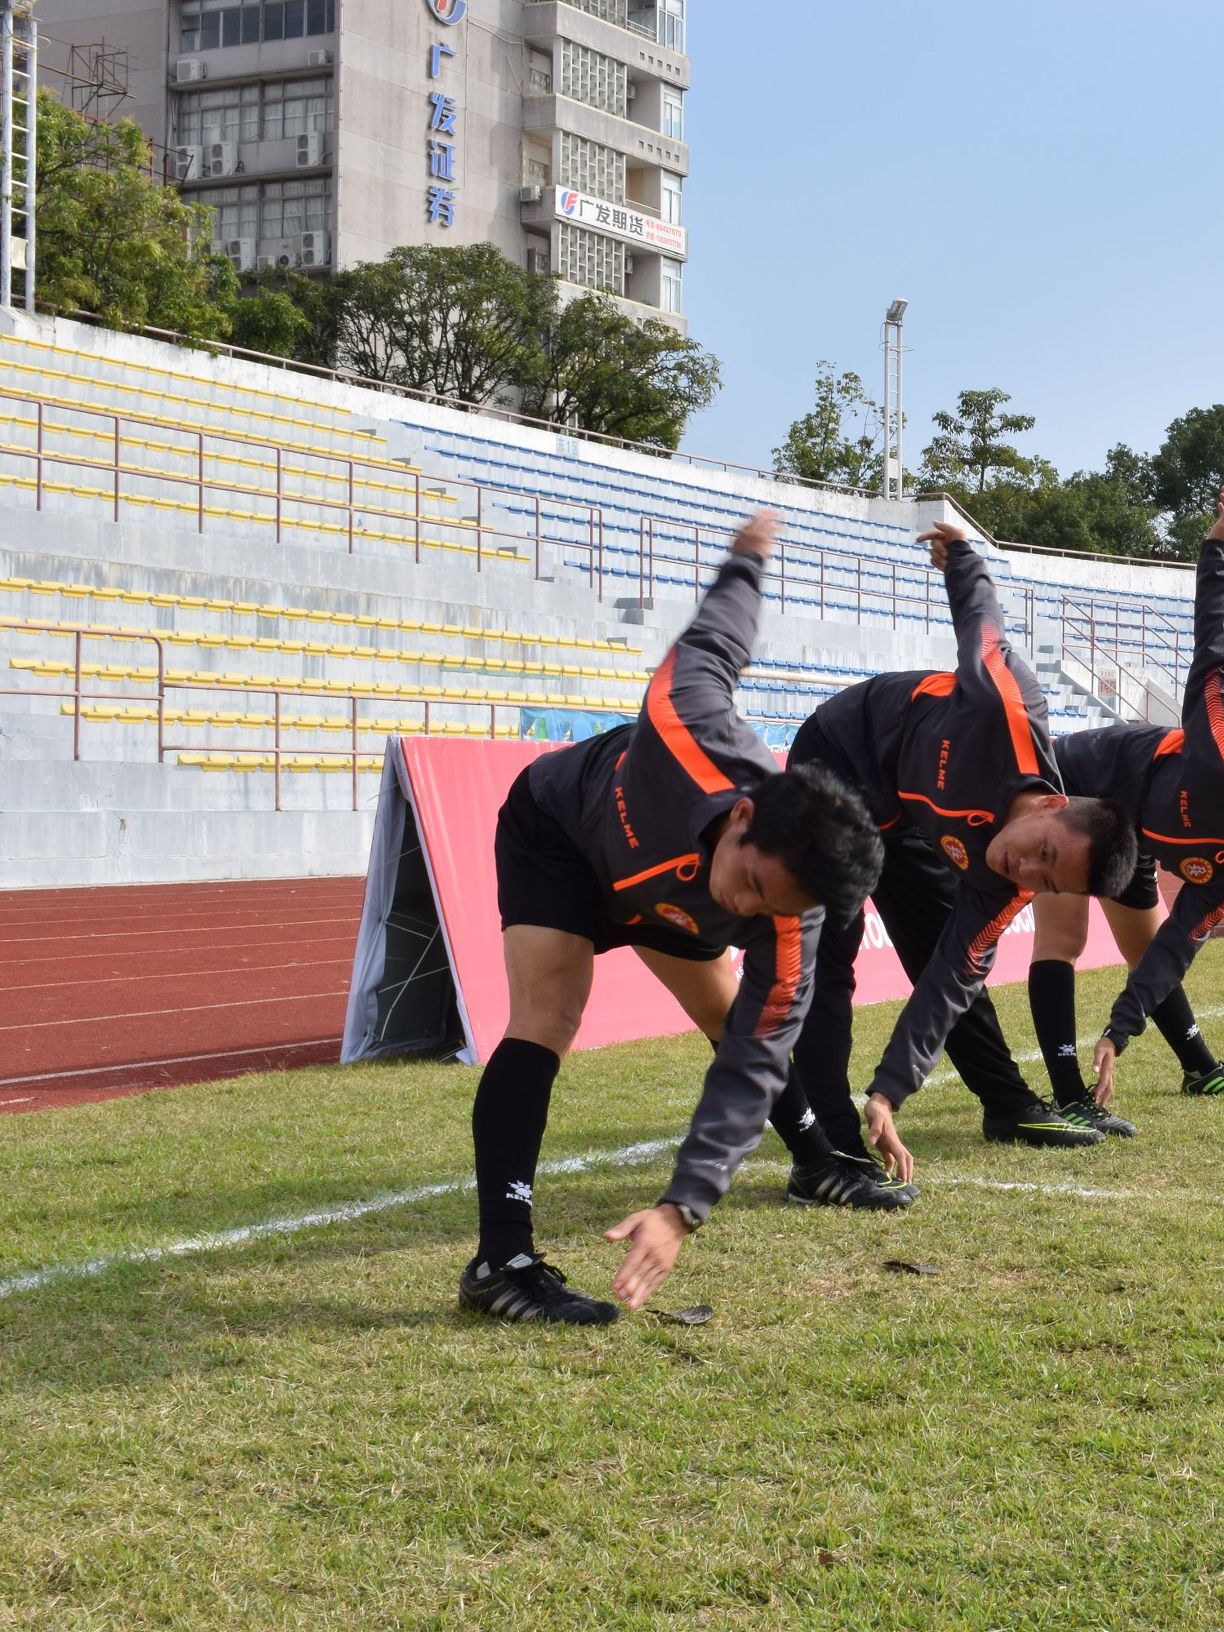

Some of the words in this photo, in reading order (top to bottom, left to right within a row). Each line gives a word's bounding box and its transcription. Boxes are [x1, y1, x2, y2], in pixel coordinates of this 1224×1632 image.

[430, 43, 459, 228] 广发证券
[578, 198, 644, 236] 广发期货
[937, 739, 950, 790] KELME
[615, 787, 639, 848] KELME
